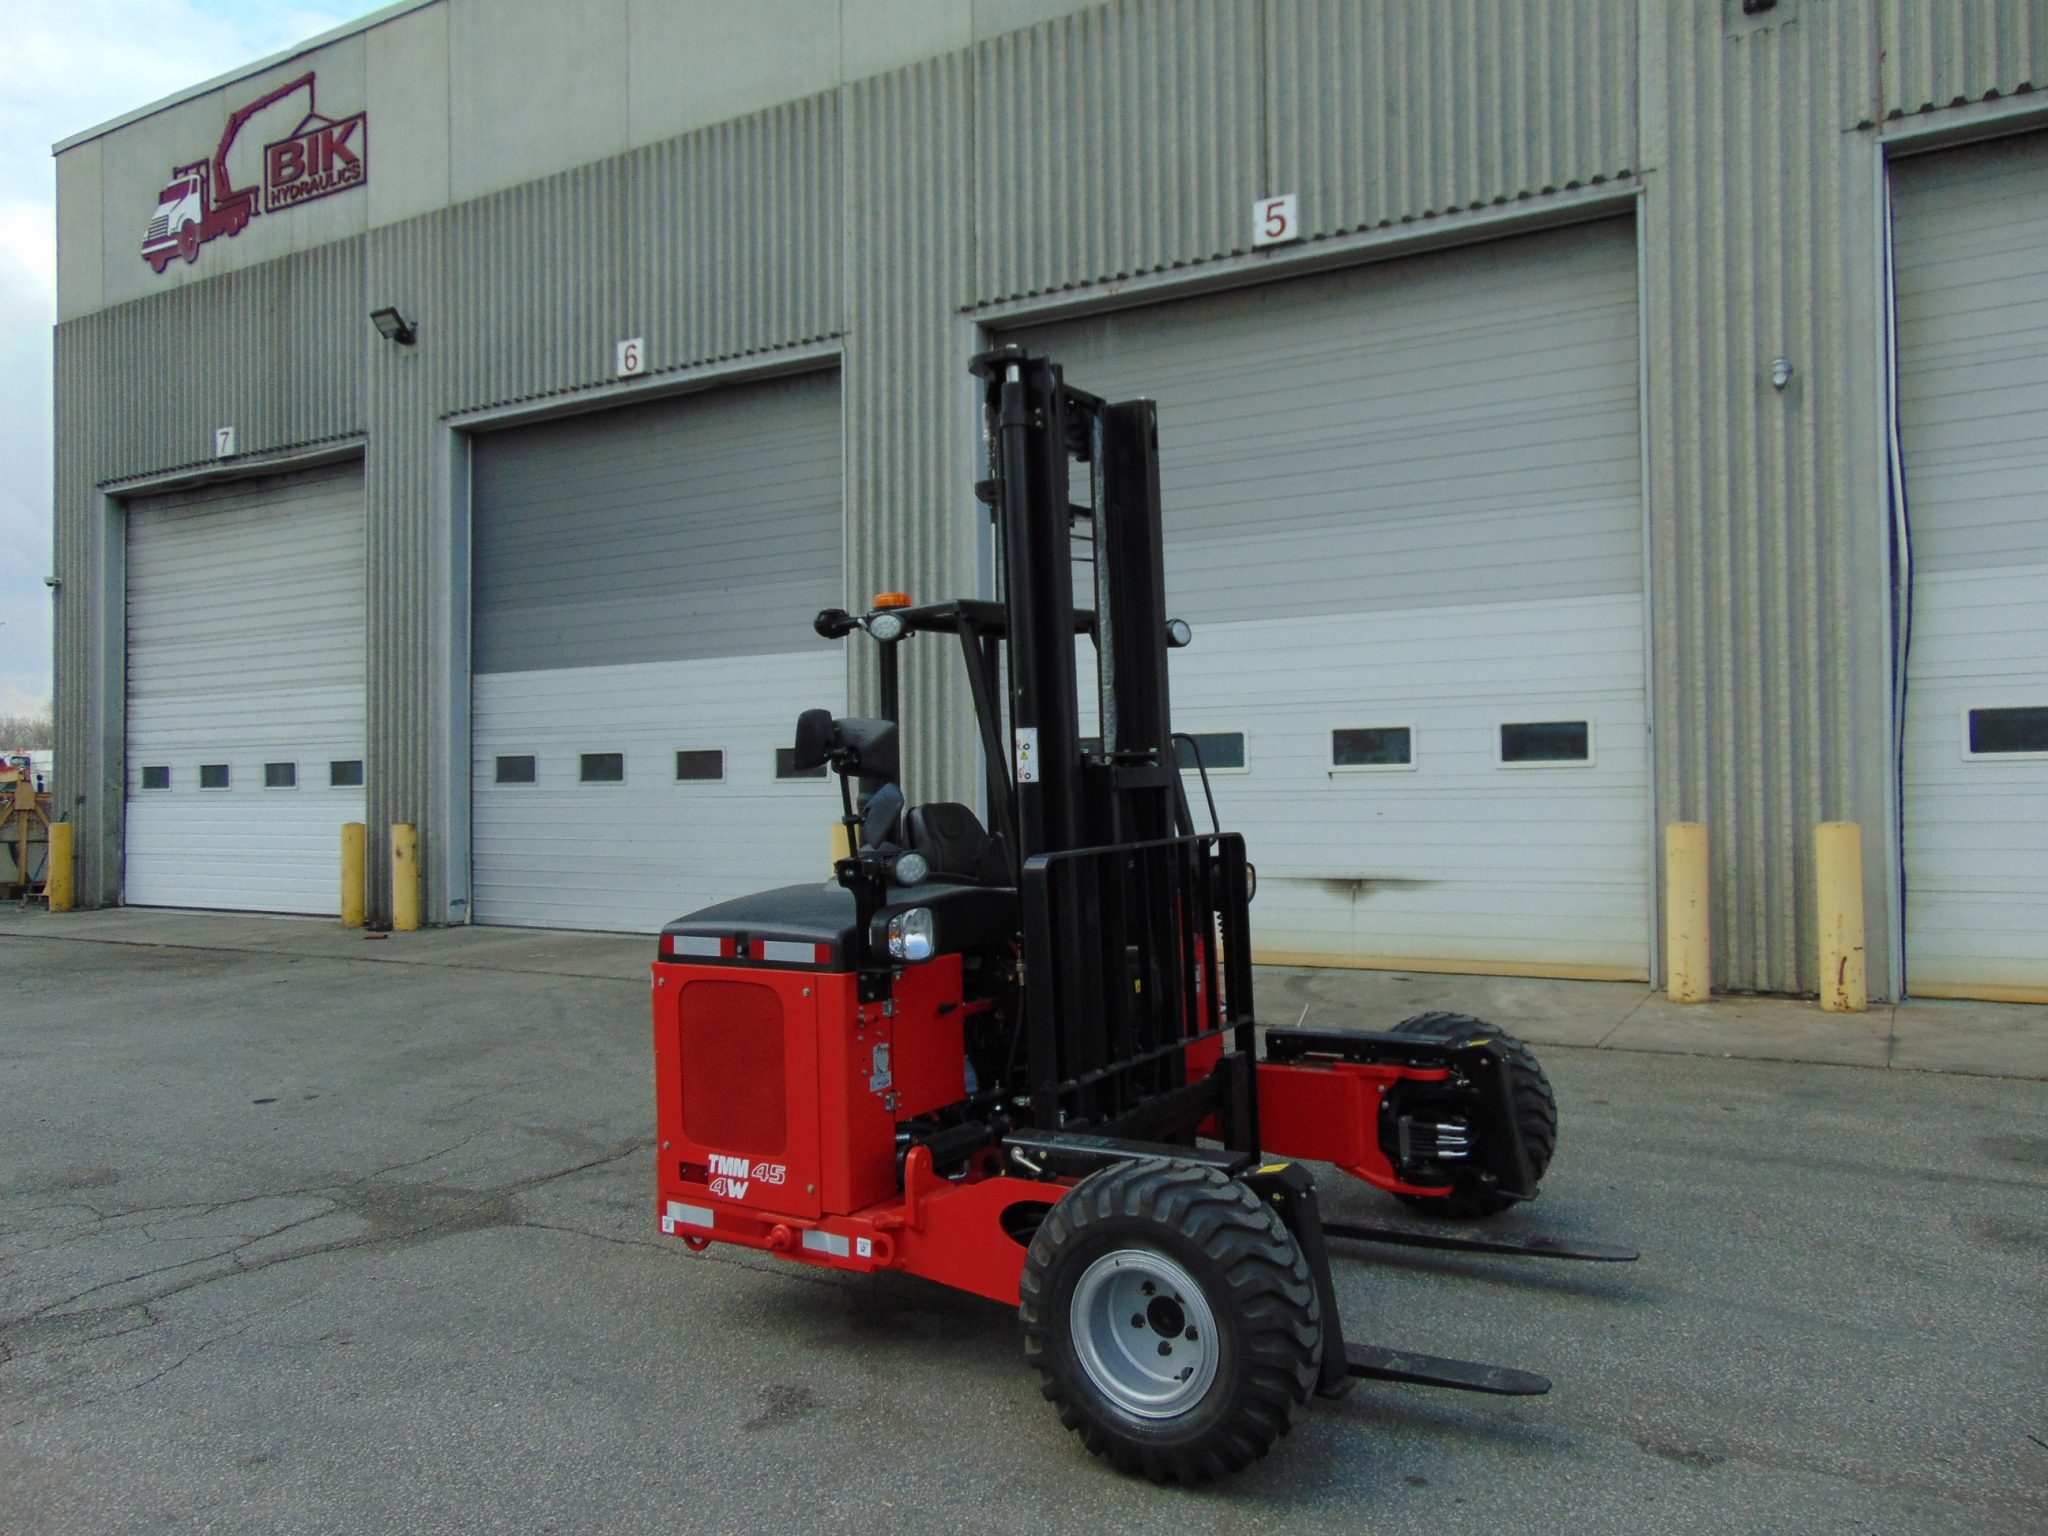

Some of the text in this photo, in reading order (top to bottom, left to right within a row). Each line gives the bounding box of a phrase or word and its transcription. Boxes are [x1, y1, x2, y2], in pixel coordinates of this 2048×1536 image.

[270, 121, 359, 188] BIK
[270, 163, 361, 206] HYDRAULICS
[1265, 200, 1287, 238] 5
[624, 343, 638, 372] 6
[220, 431, 230, 453] 7
[708, 1153, 786, 1185] TMM 45
[709, 1177, 749, 1199] 4W
